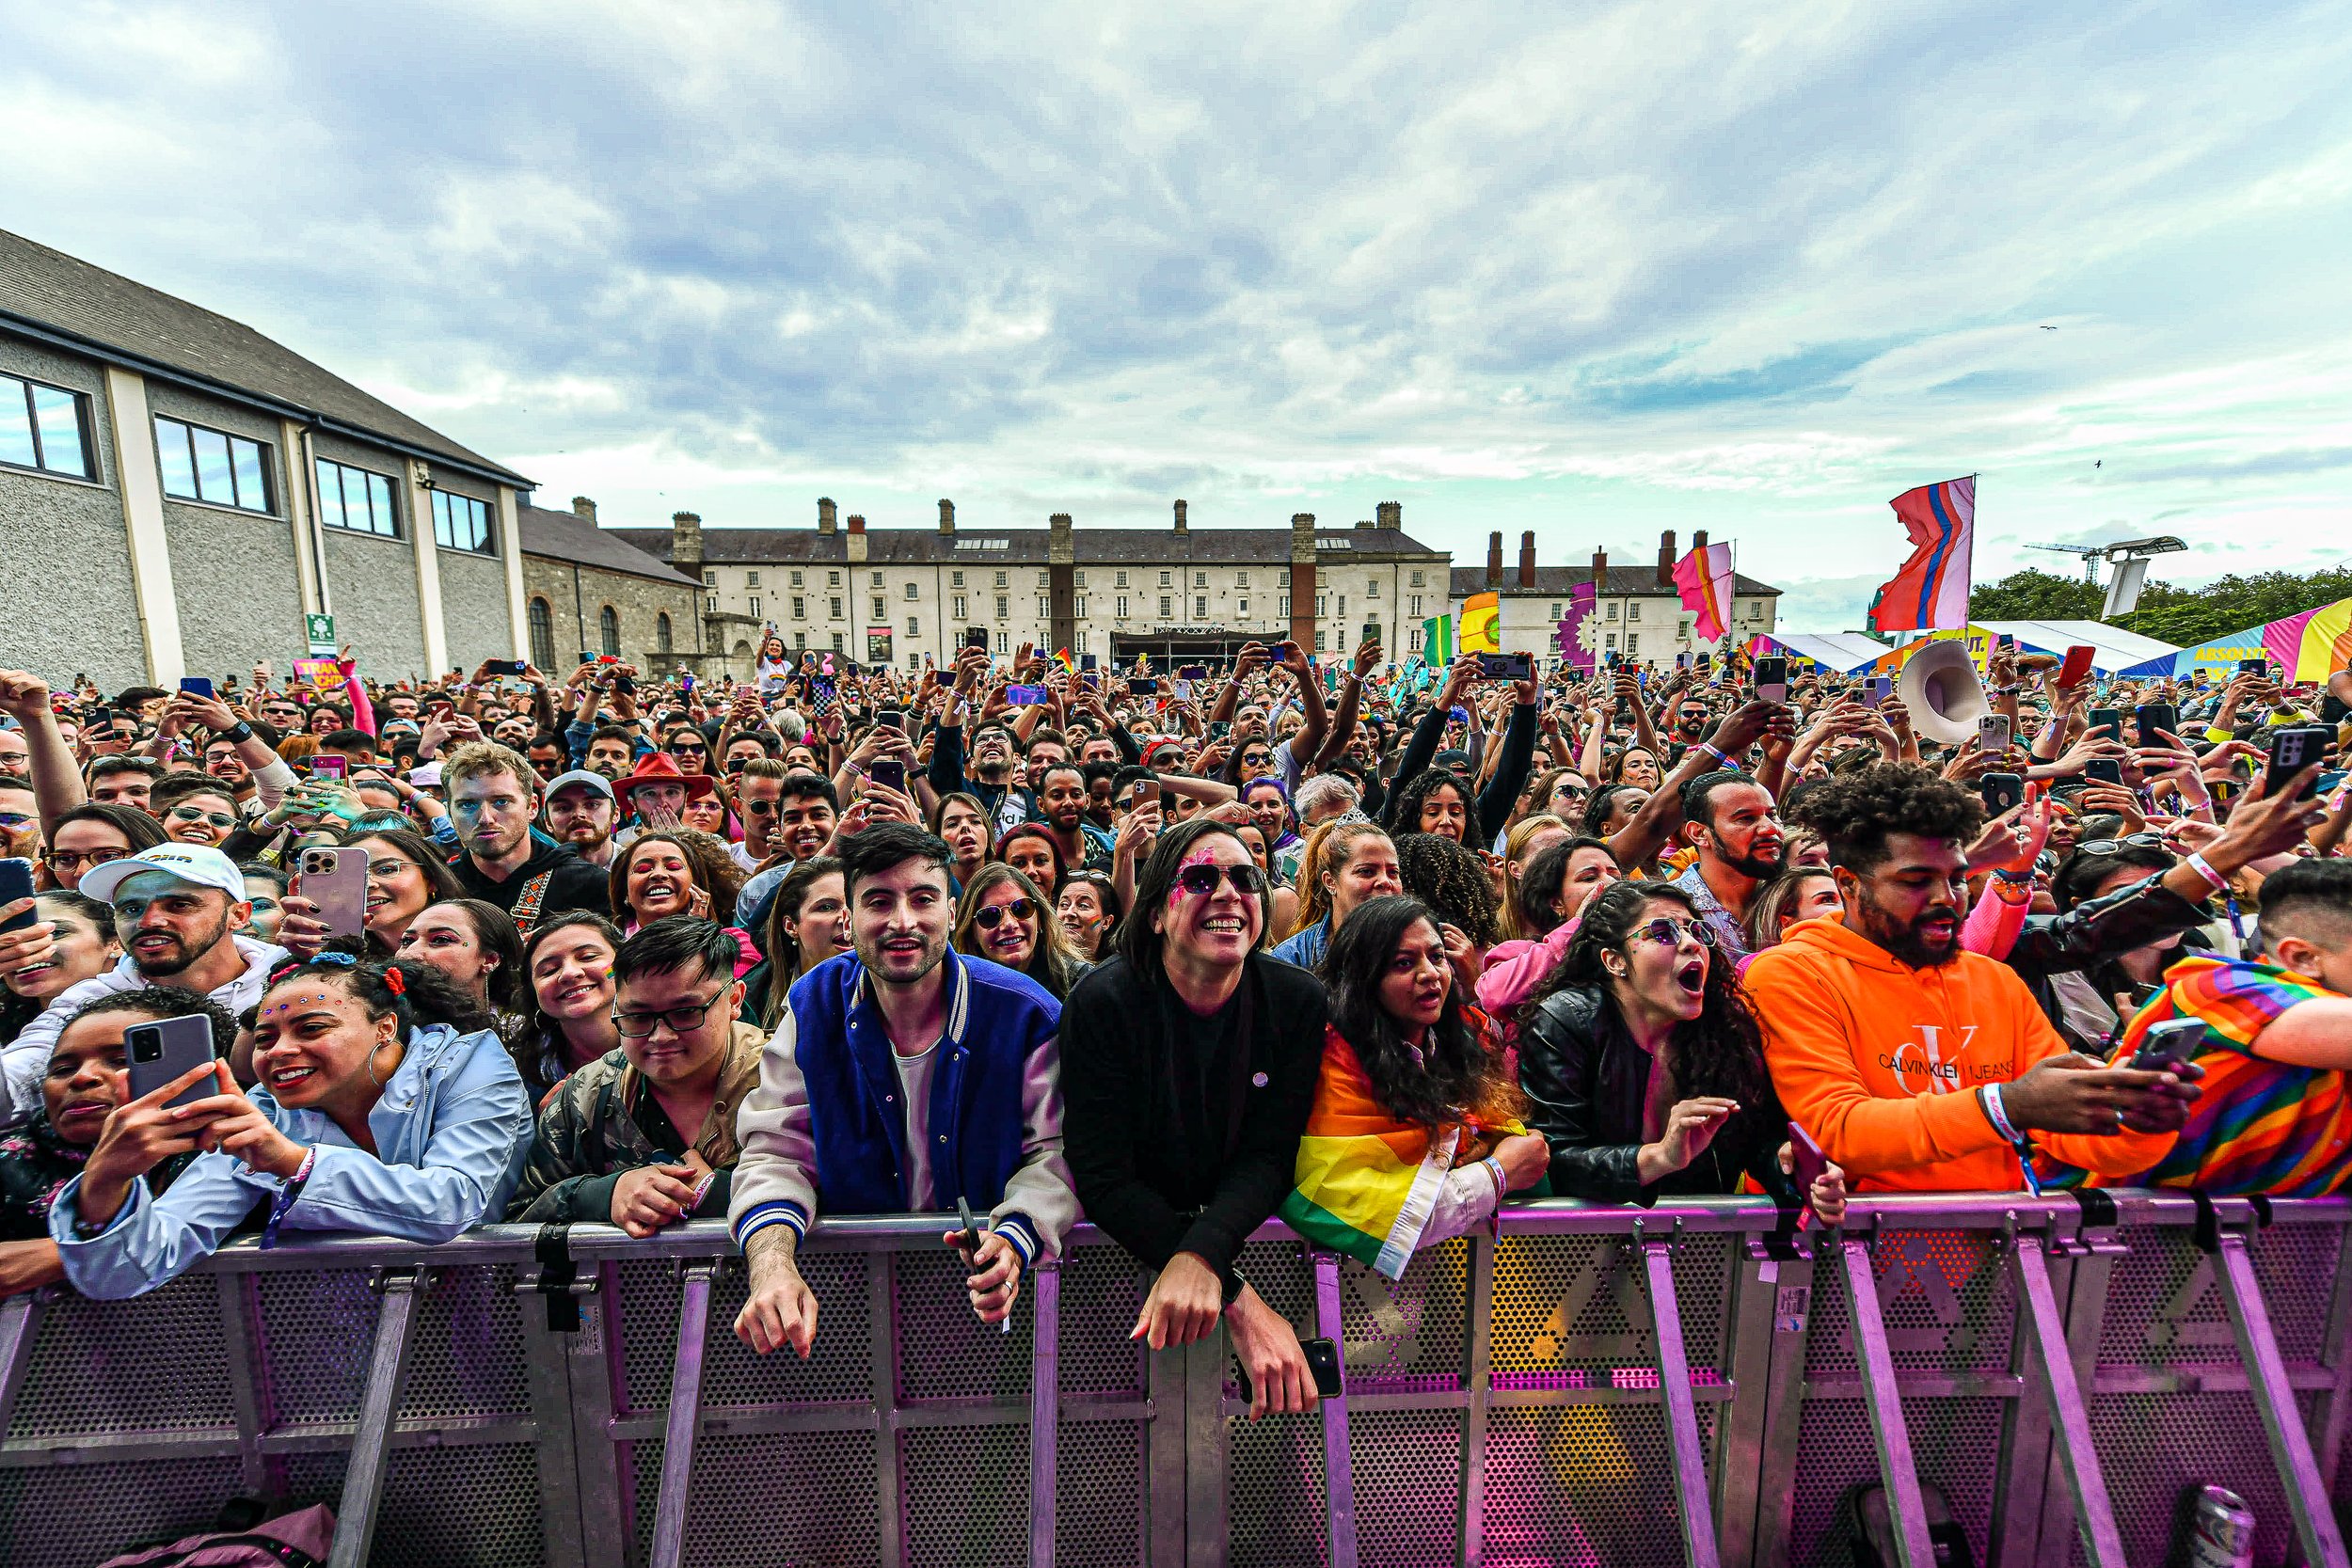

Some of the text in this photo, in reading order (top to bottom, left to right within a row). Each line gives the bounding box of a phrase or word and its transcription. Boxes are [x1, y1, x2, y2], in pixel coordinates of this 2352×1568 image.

[2194, 646, 2271, 661] ABSOLUT.
[298, 661, 340, 674] TRAN
[1879, 1053, 1929, 1075] CALVIN
